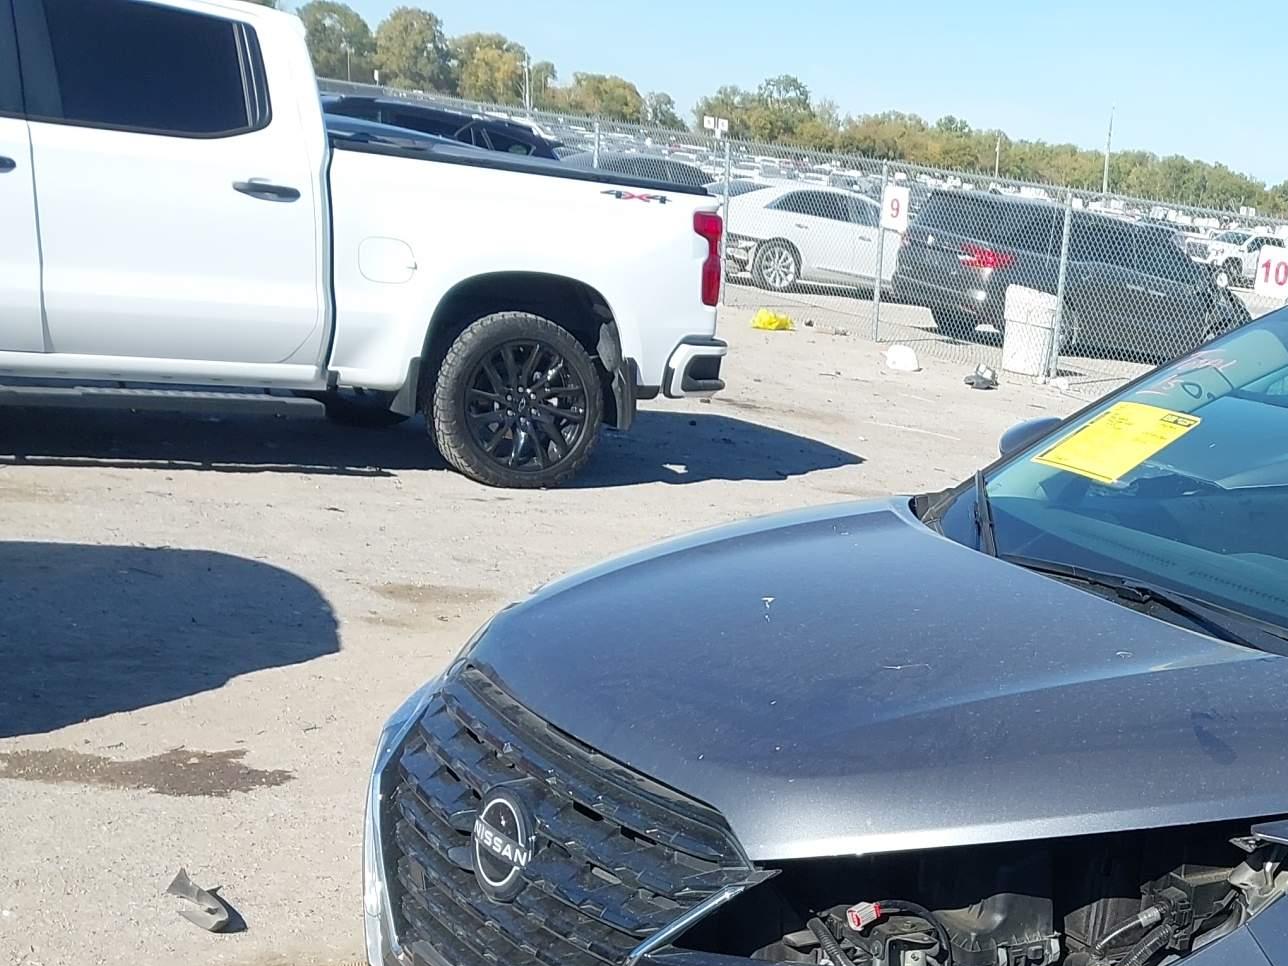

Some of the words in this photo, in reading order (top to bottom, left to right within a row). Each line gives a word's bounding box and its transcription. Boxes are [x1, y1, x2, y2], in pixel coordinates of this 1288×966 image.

[890, 198, 901, 218] 9
[1261, 258, 1288, 286] 10
[473, 819, 528, 867] NISSAN
